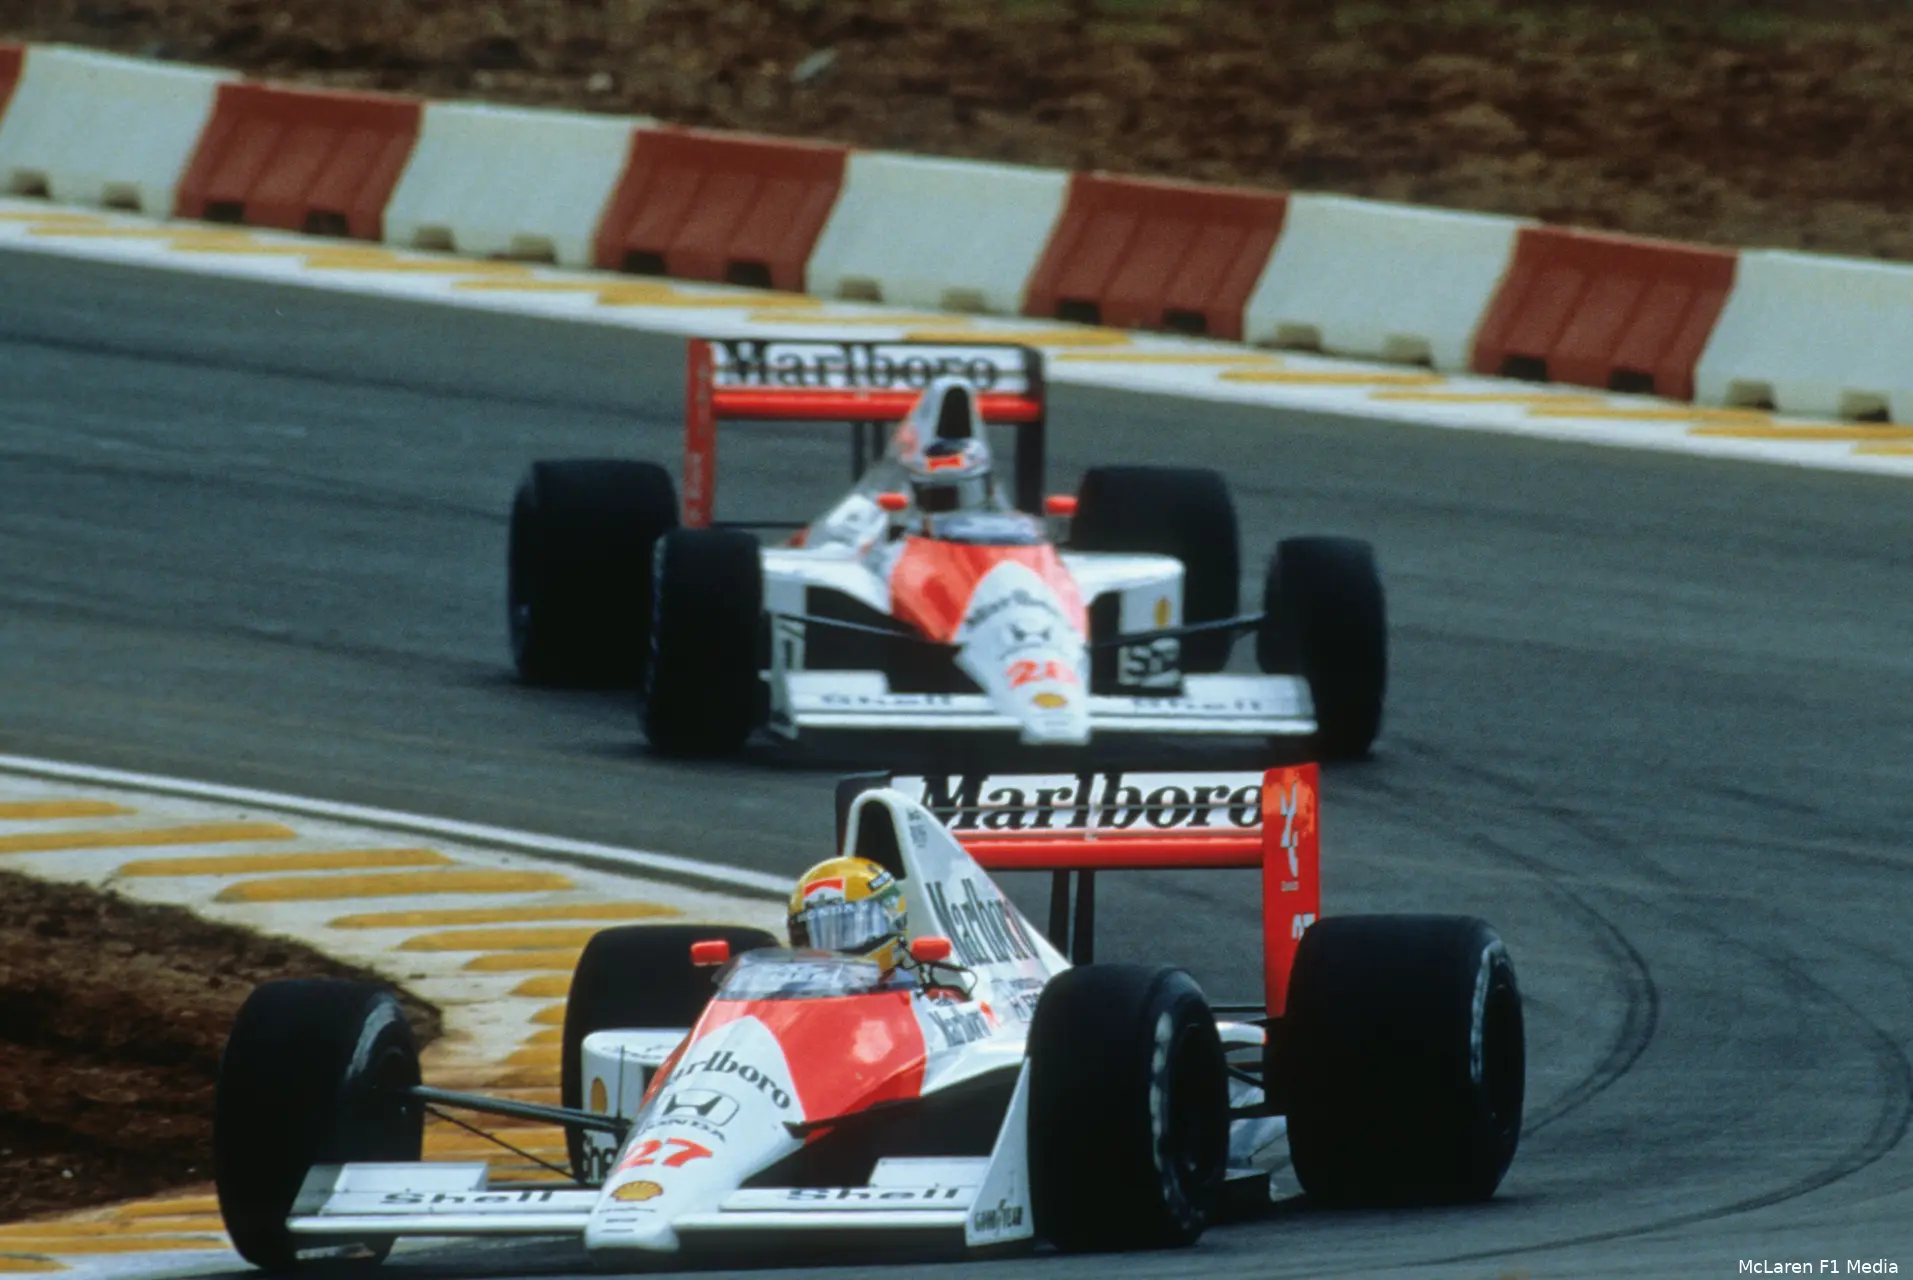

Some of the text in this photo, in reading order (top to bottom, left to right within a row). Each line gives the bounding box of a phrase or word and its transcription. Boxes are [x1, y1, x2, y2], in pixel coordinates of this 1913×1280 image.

[718, 340, 997, 389] Marlboro
[921, 774, 1263, 830] Marlboro
[616, 1137, 713, 1173] 27
[379, 1190, 553, 1204] Shell
[787, 1187, 960, 1201] Shell
